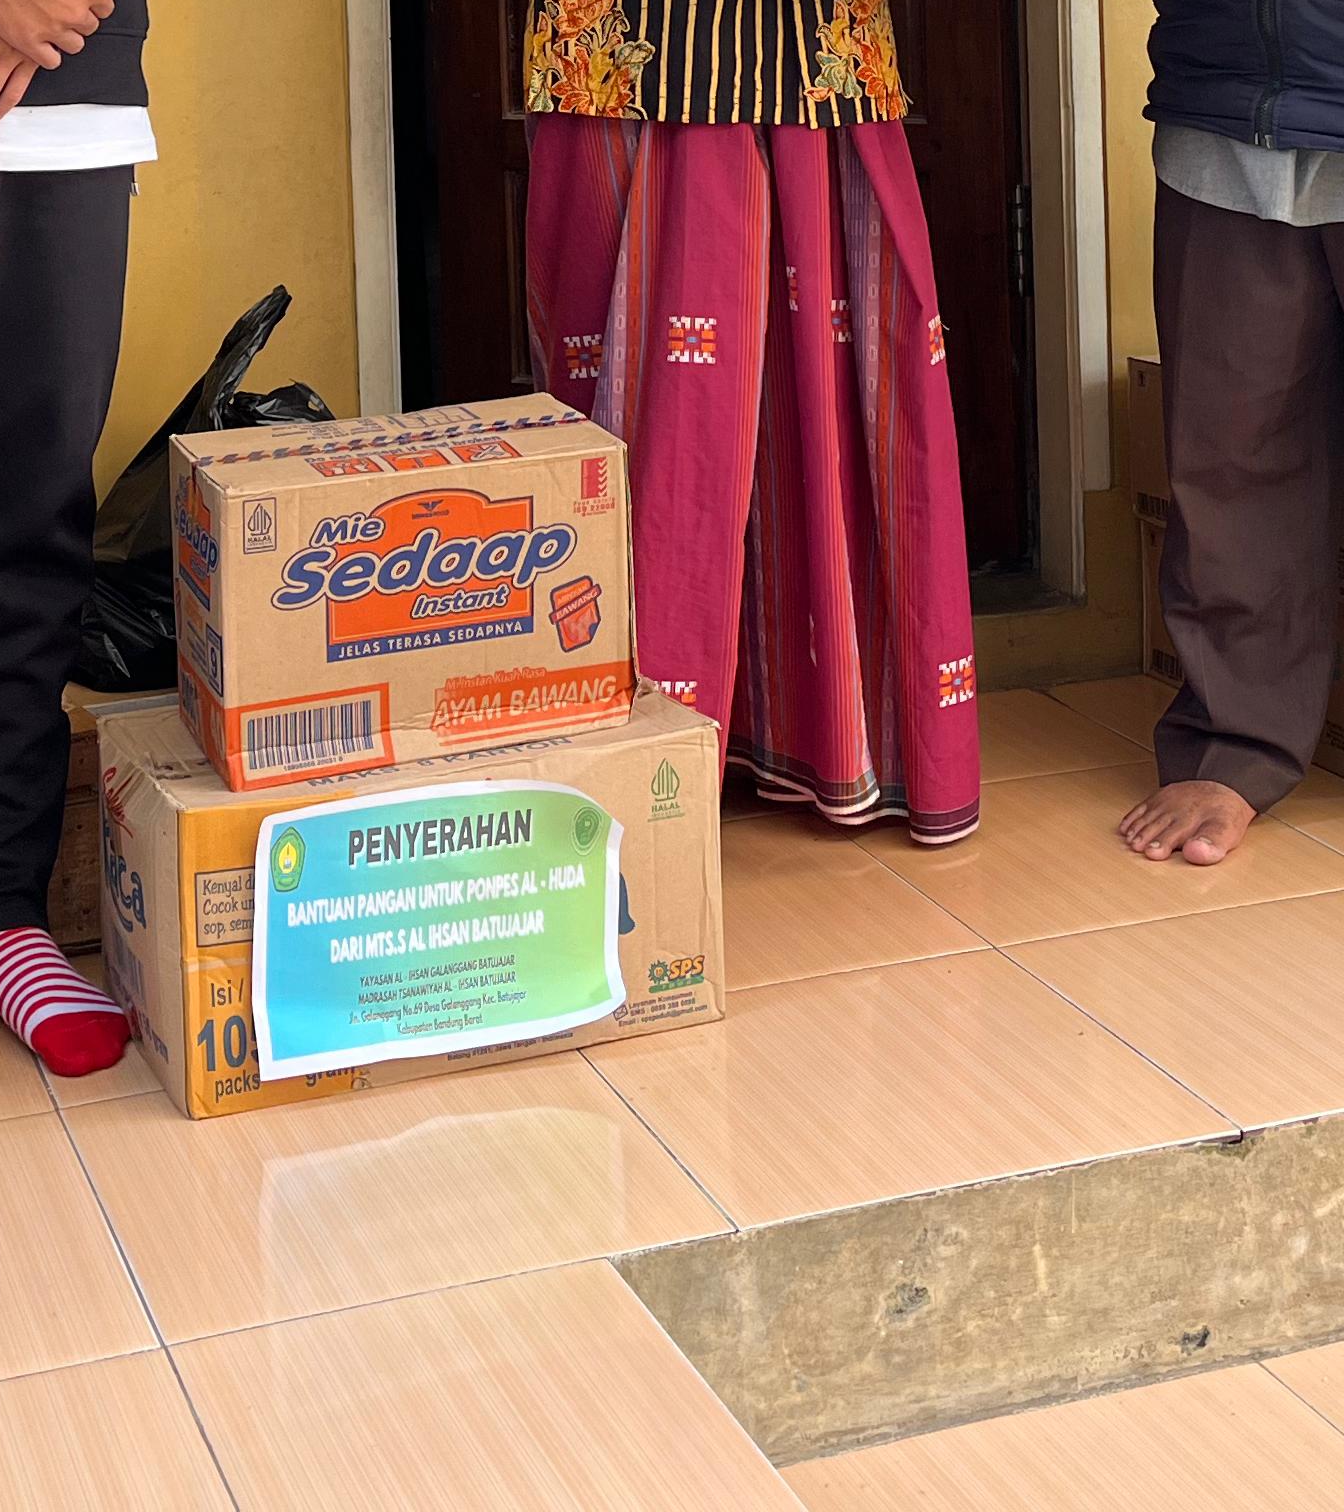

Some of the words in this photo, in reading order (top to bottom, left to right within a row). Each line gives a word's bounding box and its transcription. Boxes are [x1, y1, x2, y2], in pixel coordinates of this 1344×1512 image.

[312, 515, 383, 545] Mie
[274, 529, 573, 607] Sedaap
[412, 586, 507, 618] Instant
[556, 591, 598, 620] BAWANG
[338, 641, 381, 659] JELAS
[387, 633, 442, 653] TERASA
[448, 620, 523, 644] SEDAPNYA
[522, 667, 546, 679] Rasa
[433, 694, 502, 728] AYAM
[509, 675, 617, 716] BAWANG
[441, 737, 573, 764] KARTON
[651, 802, 681, 813] HALAL
[348, 809, 533, 867] PENYERAHAN
[203, 875, 243, 897] Kenyal
[287, 896, 355, 928] BANTUAN
[357, 888, 417, 919] PANGAN
[418, 881, 465, 910] UNTUK
[466, 874, 519, 904] PONPES
[520, 872, 538, 897] AL
[548, 864, 586, 890] HUDA
[203, 896, 239, 916] Cocok
[203, 922, 226, 939] sop,
[330, 936, 362, 964] DARI
[364, 929, 406, 958] MTS.S
[408, 929, 426, 953] AL
[428, 920, 471, 951] IHSAN
[472, 910, 545, 941] BATUJAJAR
[360, 972, 394, 988] YAYASAN
[394, 972, 404, 984] AL
[408, 967, 429, 981] IHSAN
[430, 960, 478, 977] GALANGGANG
[478, 954, 516, 969] BATUJAJAR
[668, 954, 706, 982] SPS
[211, 979, 233, 1008] Isi
[358, 989, 398, 1005] MADRASAH
[399, 982, 443, 1000] TSANAWIYAH
[443, 980, 453, 994] AL
[458, 977, 479, 990] IHSAN
[479, 972, 516, 987] BATUJAJAR
[424, 1001, 441, 1014] Desa
[441, 997, 482, 1012] Galanggang
[482, 993, 496, 1005] Kec.
[397, 1020, 433, 1035] Kabupaten
[434, 1016, 464, 1031] Bandung
[464, 1014, 483, 1027] Barat
[197, 1015, 260, 1072] 10
[215, 1070, 261, 1104] packs
